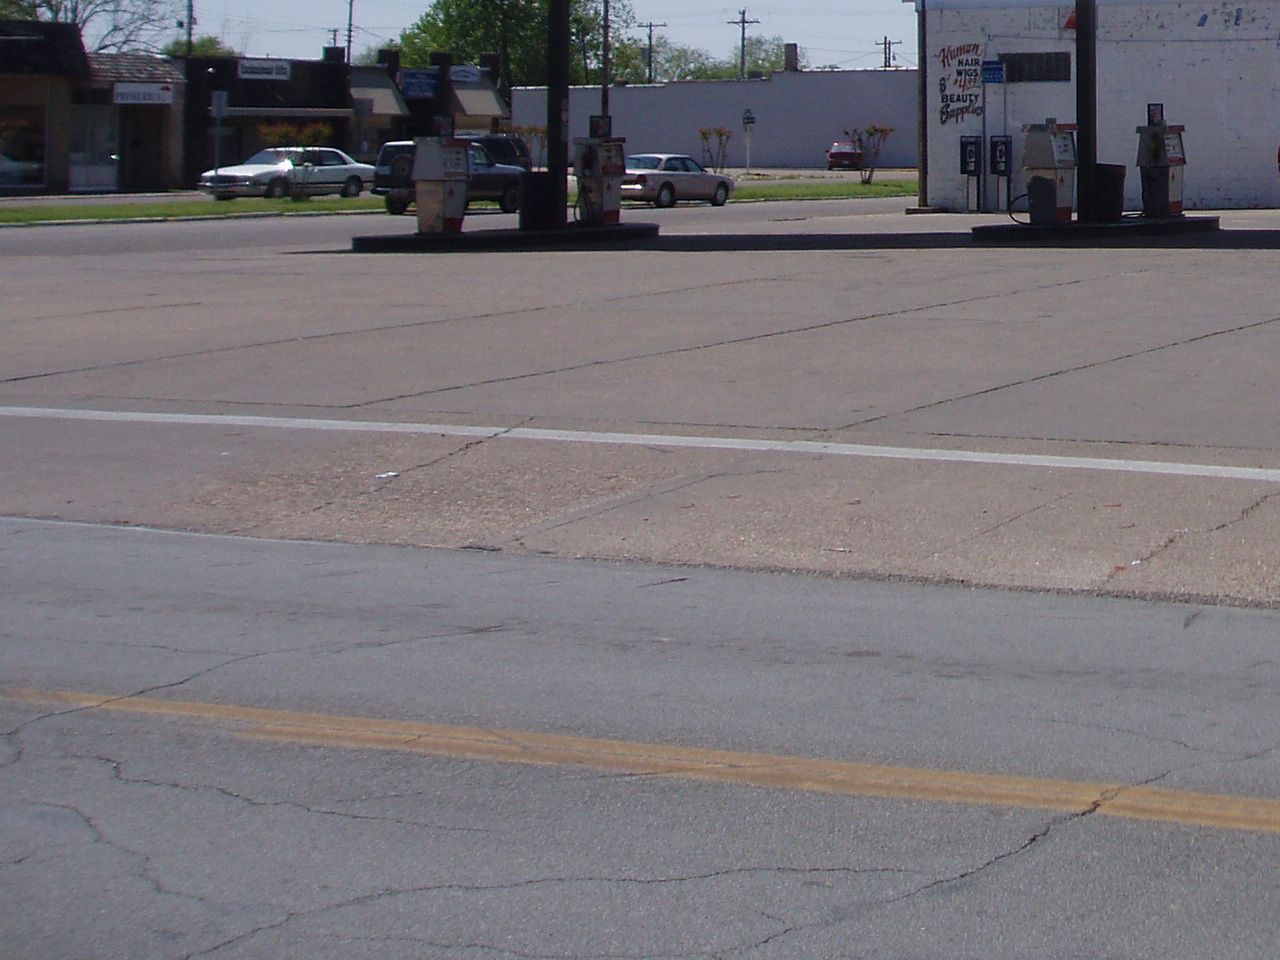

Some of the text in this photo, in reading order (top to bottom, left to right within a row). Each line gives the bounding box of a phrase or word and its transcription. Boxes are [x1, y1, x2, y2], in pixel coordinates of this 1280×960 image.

[957, 58, 981, 68] HAIR
[955, 68, 979, 78] WIGS
[941, 93, 980, 104] BEAUTY
